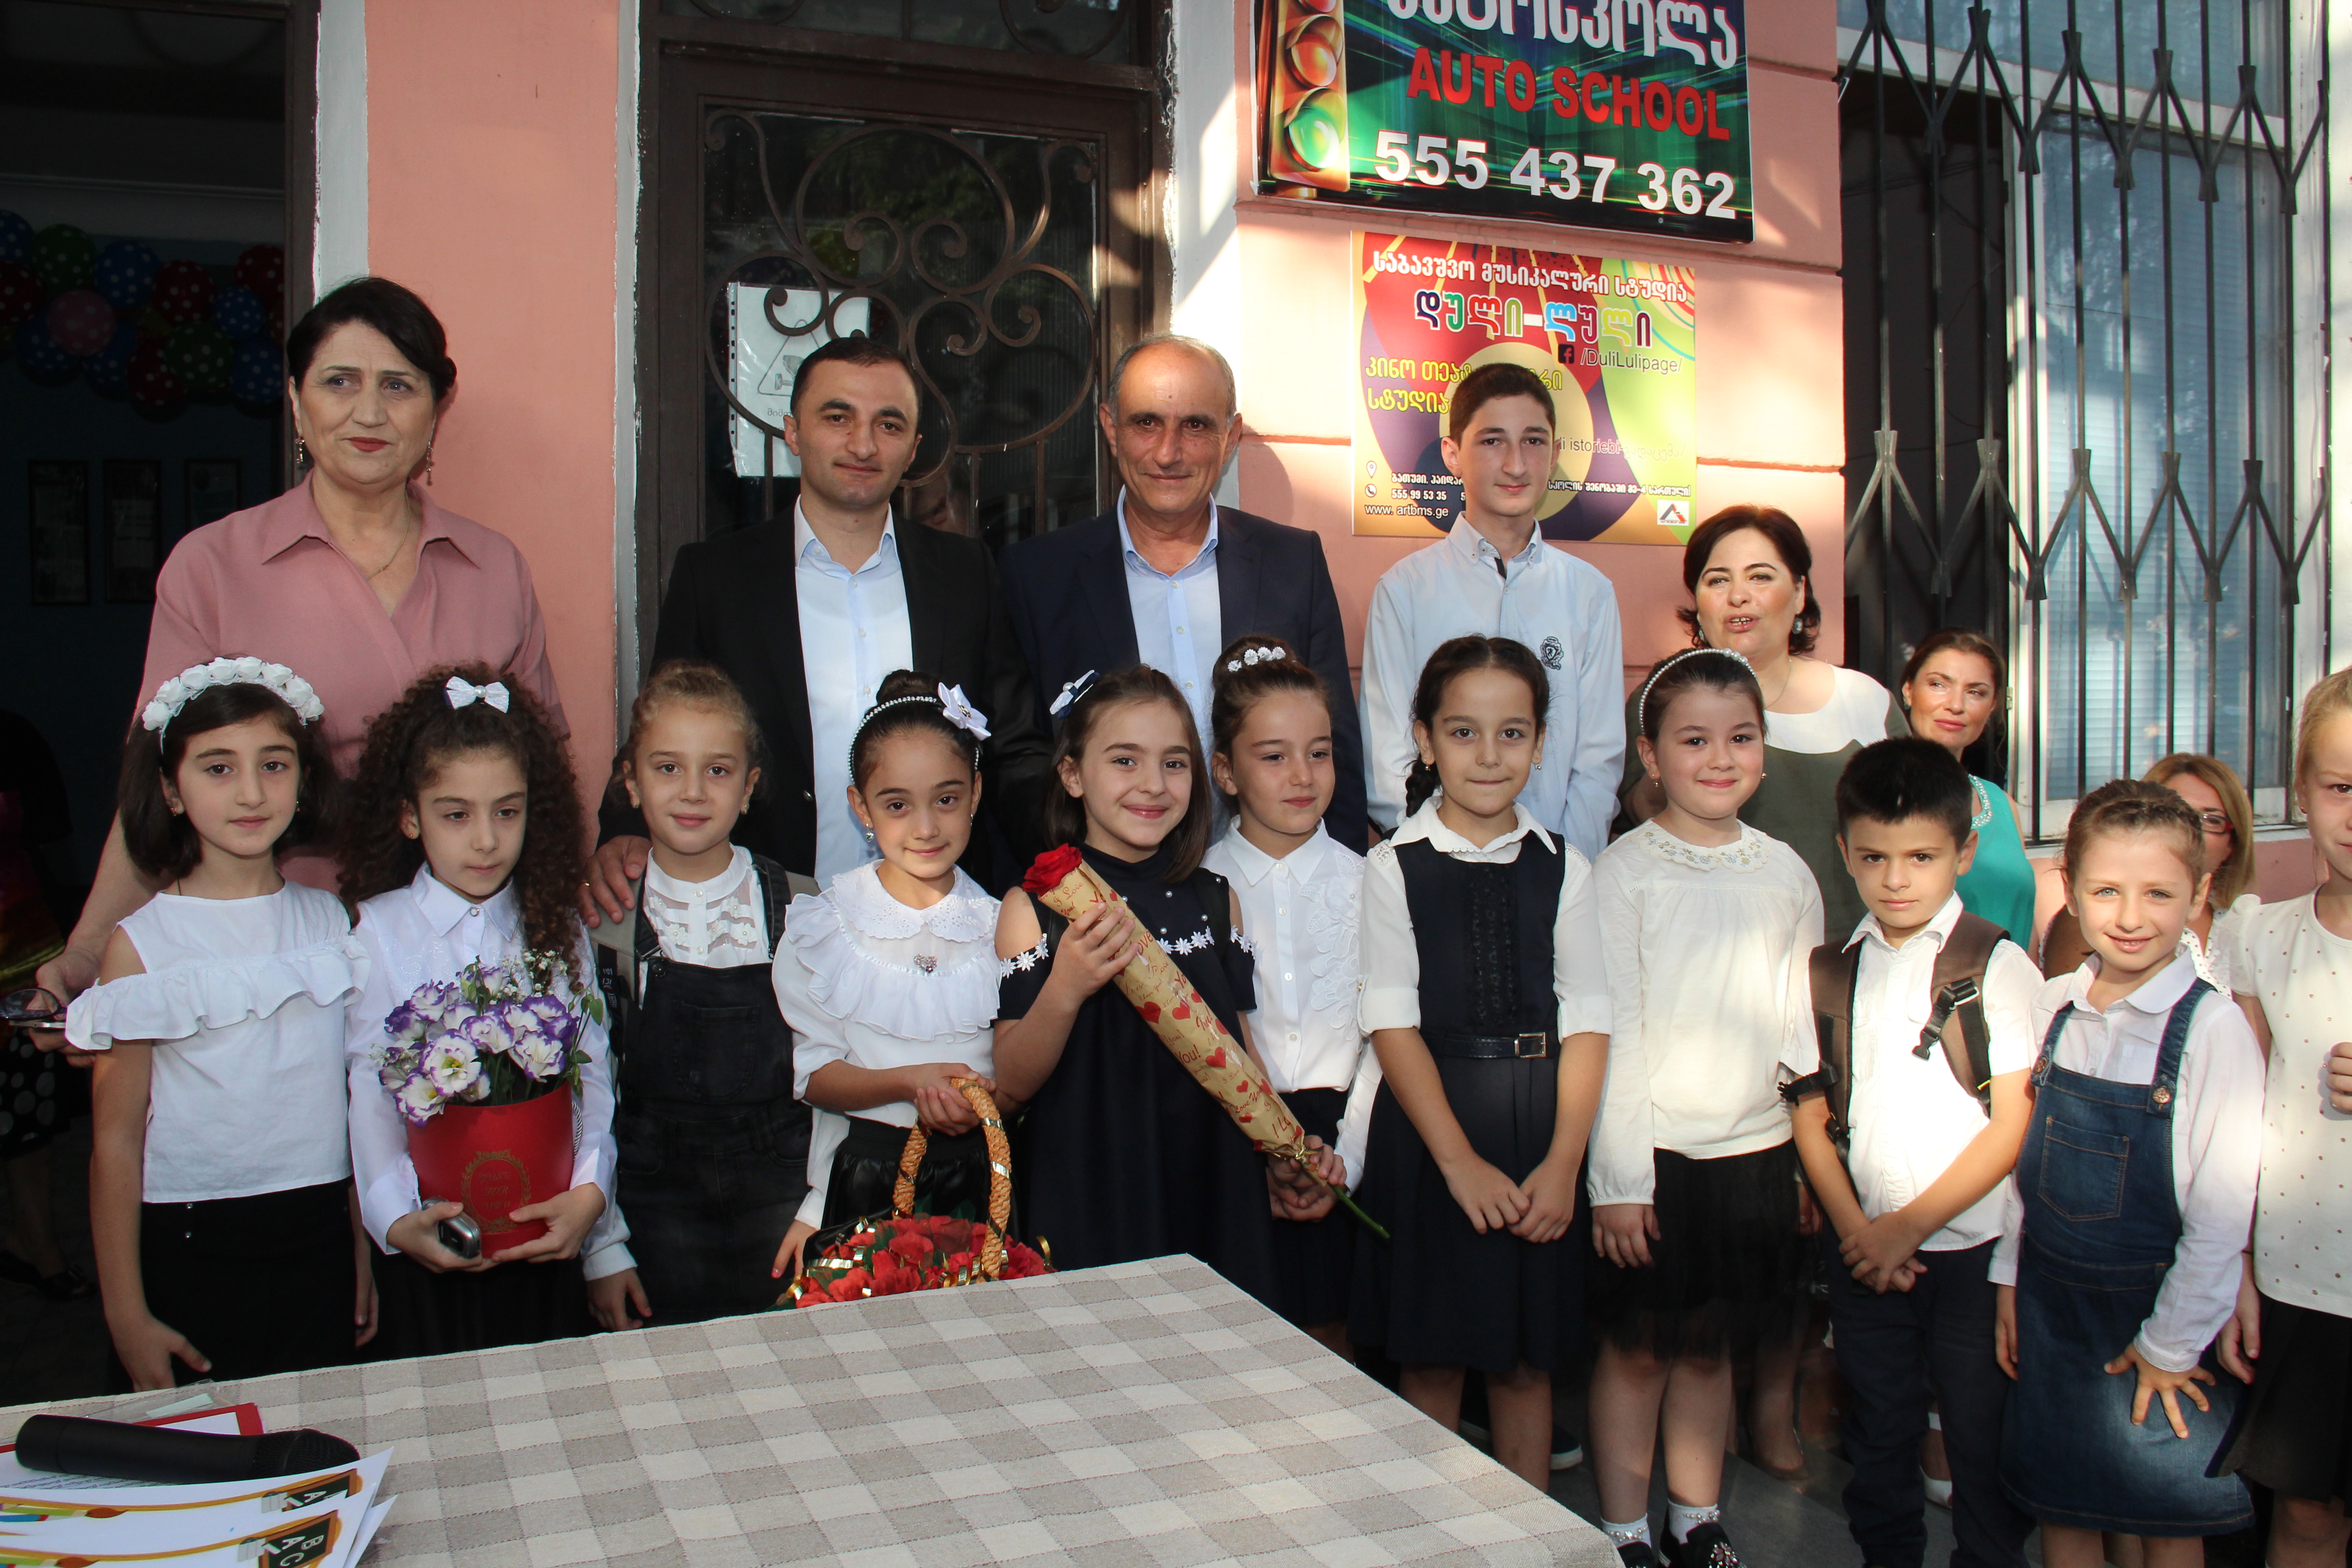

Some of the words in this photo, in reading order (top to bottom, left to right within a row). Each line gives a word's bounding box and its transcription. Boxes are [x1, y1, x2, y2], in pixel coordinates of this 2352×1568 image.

[1406, 46, 1537, 113] AUTO
[1552, 65, 1731, 141] SCHOOL
[1374, 129, 1490, 190] 555
[1509, 146, 1617, 204] 437
[1636, 162, 1737, 220] 362
[1373, 250, 1475, 280] საბავშვო
[1481, 262, 1609, 295] მუსიკალური
[1614, 275, 1688, 303] სტუდია
[1365, 356, 1416, 379] კინო
[1367, 387, 1449, 414] სტუდია
[1392, 489, 1408, 499] 555
[1410, 489, 1421, 500] 99
[1423, 490, 1434, 500] 53
[1436, 490, 1447, 501] 35
[1365, 505, 1393, 514] www.
[1396, 504, 1449, 519] artbms.ge
[1062, 882, 1083, 900] Love
[1174, 1044, 1201, 1064] You!
